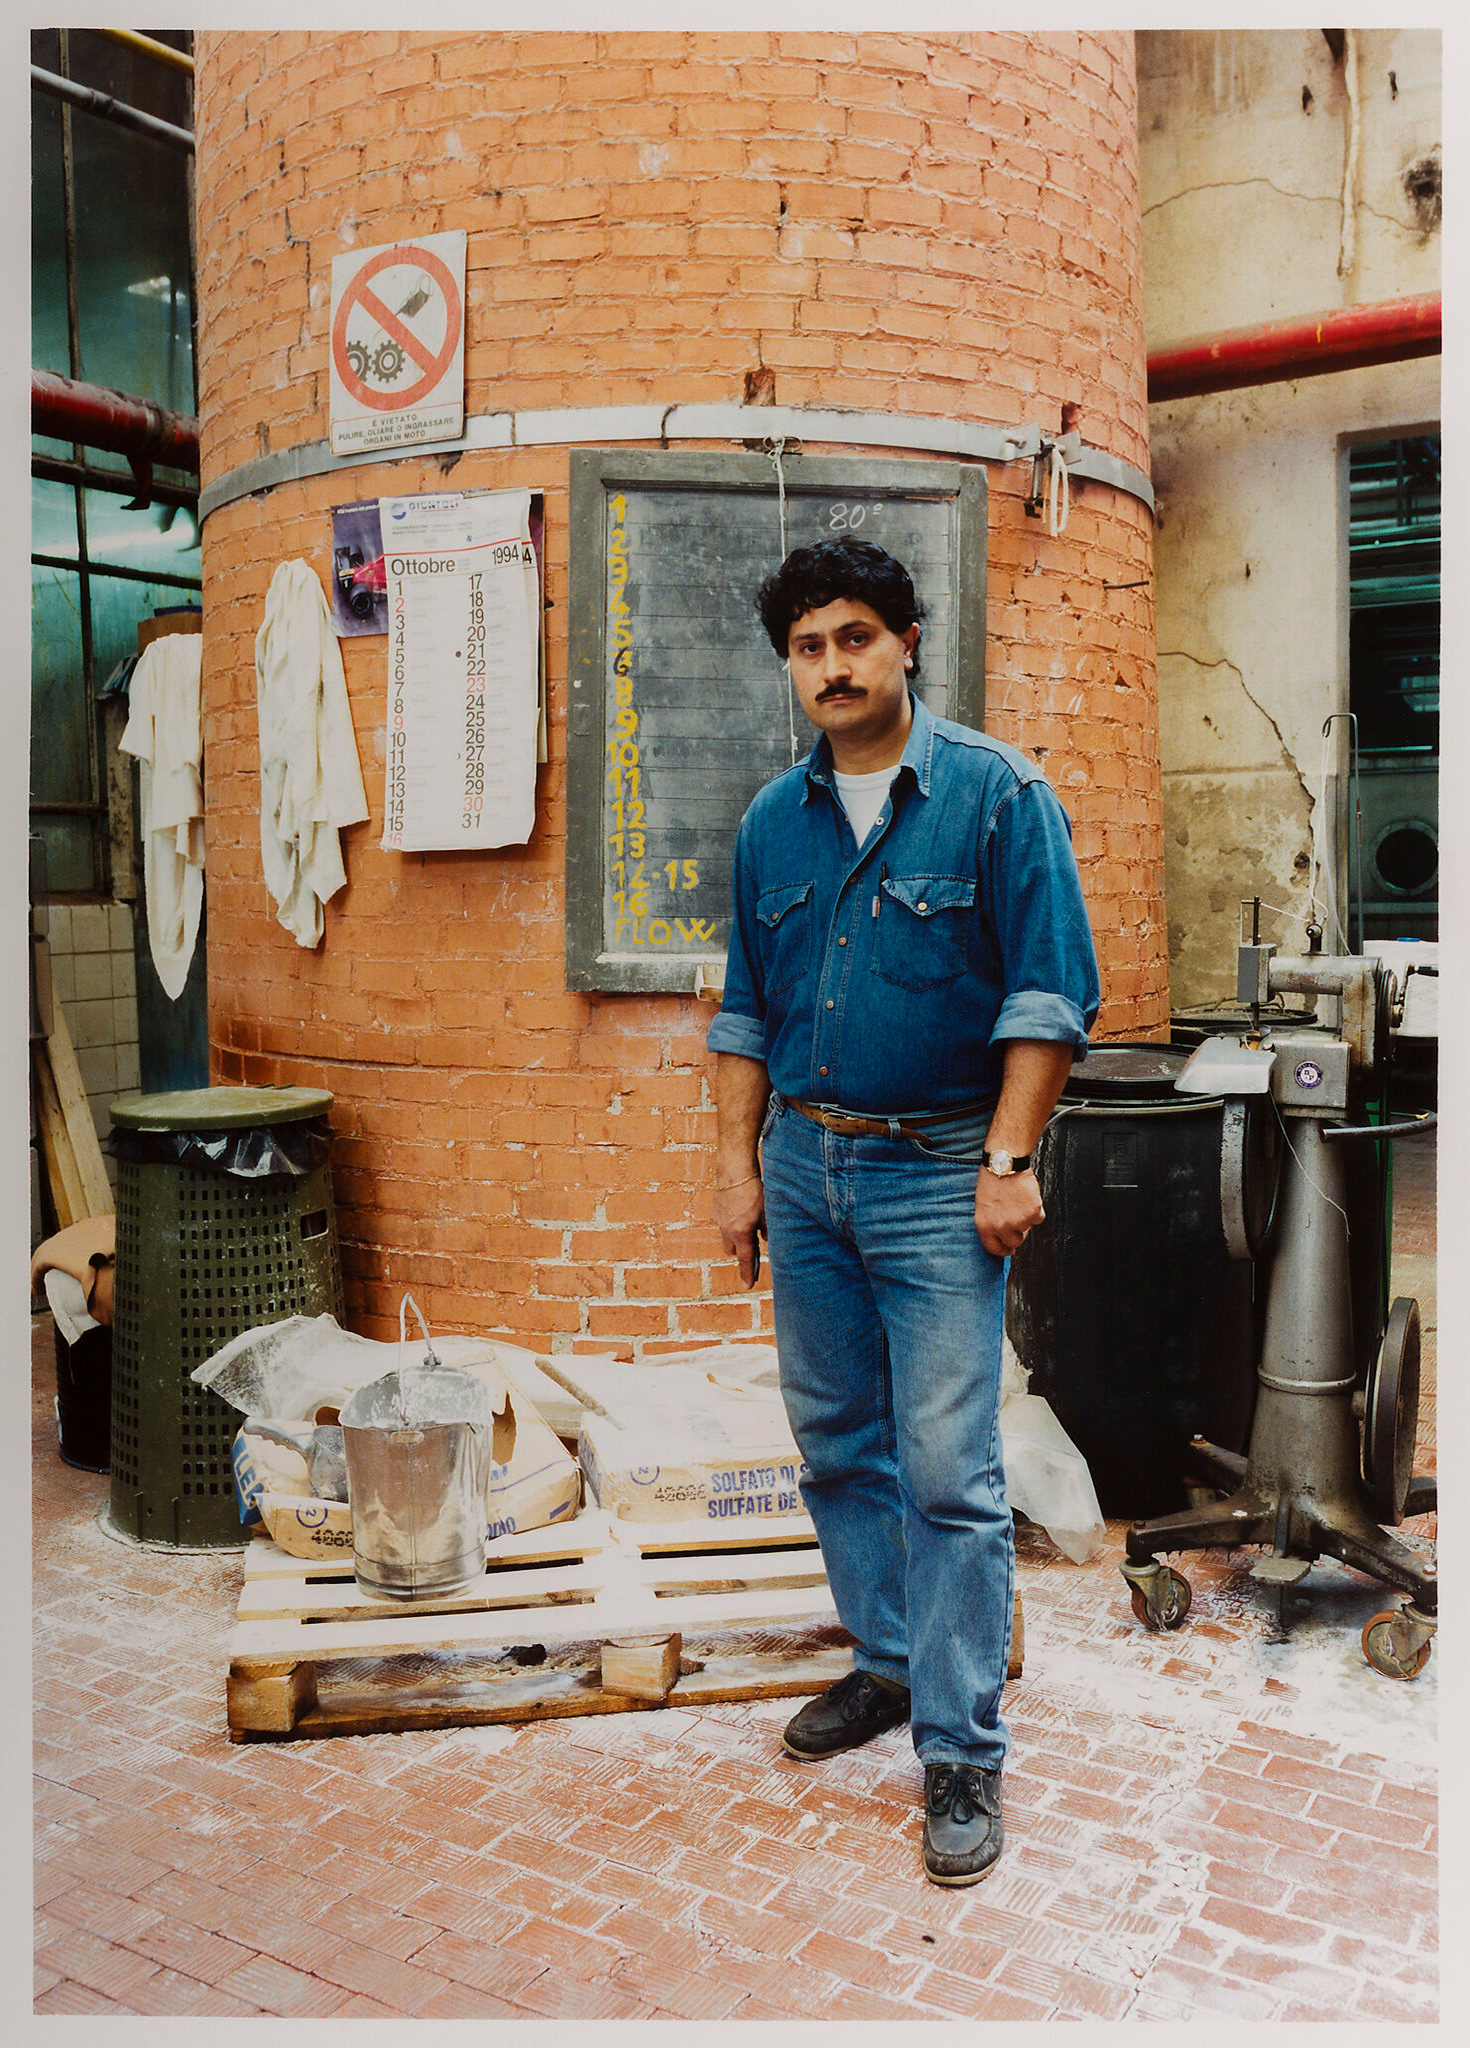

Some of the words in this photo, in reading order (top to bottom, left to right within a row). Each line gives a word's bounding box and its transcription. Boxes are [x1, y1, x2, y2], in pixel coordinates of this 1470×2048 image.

[367, 426, 394, 436] OLIARE
[404, 416, 455, 431] INGRASSARE
[381, 414, 417, 426] VIETATO
[363, 435, 391, 445] ORGANI
[403, 430, 426, 439] MOTO
[609, 494, 627, 523] 1
[609, 529, 628, 554] 2
[391, 558, 456, 576] Ottobre
[492, 544, 519, 565] 1994
[608, 556, 628, 585] 3
[396, 580, 403, 596] 1
[468, 573, 483, 590] 17
[395, 597, 405, 613] 2
[468, 591, 484, 607] 18
[609, 587, 630, 616] 4
[395, 614, 405, 630] 3
[468, 608, 484, 624] 19
[395, 631, 405, 646] 4
[467, 625, 486, 642] 20
[611, 619, 633, 648] 5
[395, 648, 405, 663] 5
[466, 643, 484, 659] 21
[394, 665, 404, 680] 6
[466, 660, 486, 676] 22
[394, 681, 405, 697] 7
[466, 677, 486, 693] 23
[615, 677, 633, 706] 8
[394, 698, 404, 714] 8
[465, 694, 485, 710] 24
[393, 715, 404, 731] 9
[466, 711, 485, 727] 25
[614, 708, 638, 739] 9
[390, 732, 406, 747] 10
[465, 728, 485, 744] 26
[390, 748, 404, 764] 11
[465, 745, 485, 761] 27
[605, 741, 639, 767] 10
[390, 765, 405, 780] 12
[465, 762, 485, 778] 28
[389, 782, 405, 798] 13
[464, 779, 484, 795] 29
[608, 767, 640, 798] 11
[388, 799, 404, 814] 14
[462, 796, 484, 812] 30
[388, 816, 404, 831] 15
[461, 813, 480, 829] 31
[610, 800, 647, 831] 12
[609, 832, 646, 858] 13
[612, 890, 648, 917] 16
[616, 917, 717, 945] FLOW
[711, 1467, 776, 1494] SOLFATO
[780, 1464, 796, 1485] DI
[707, 1494, 773, 1518] SULFATE
[777, 1491, 797, 1511] DE
